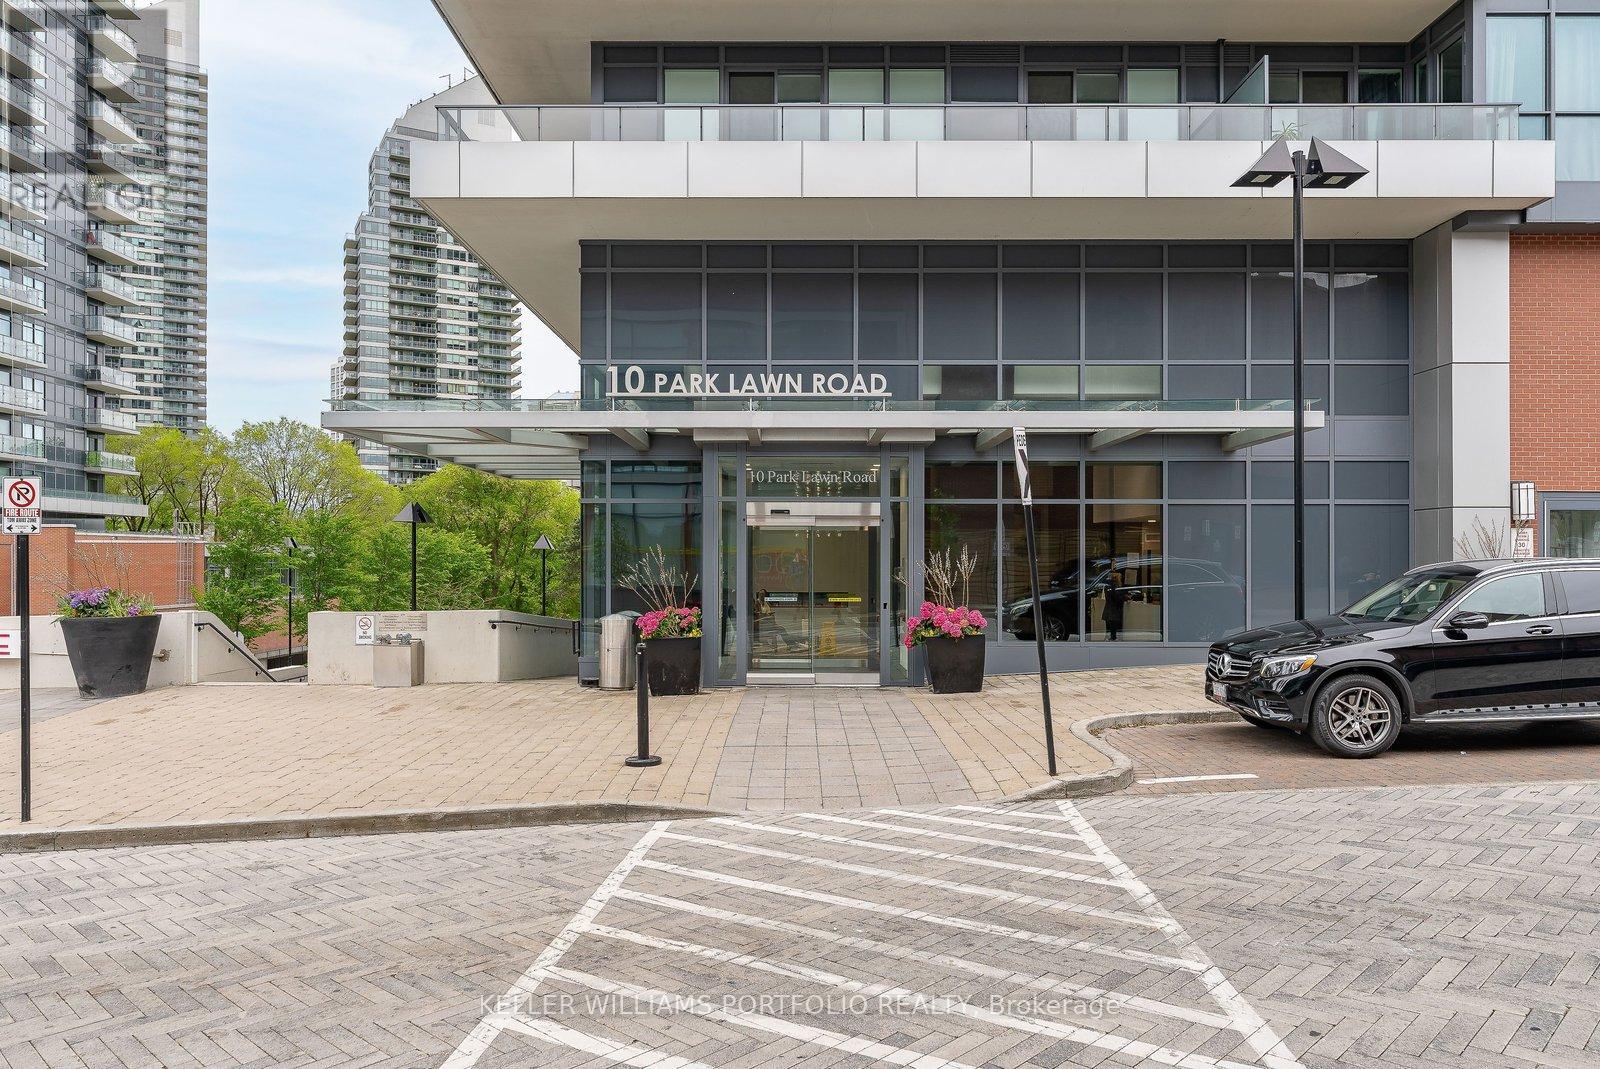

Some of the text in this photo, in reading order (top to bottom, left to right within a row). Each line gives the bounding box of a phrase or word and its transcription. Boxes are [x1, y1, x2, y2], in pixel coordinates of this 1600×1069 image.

[607, 365, 887, 395] 10 PARK LAWN ROAD
[768, 470, 796, 483] Park
[801, 470, 838, 483] Lawn
[842, 469, 877, 483] Road
[5, 508, 39, 517] FIRE ROUTE
